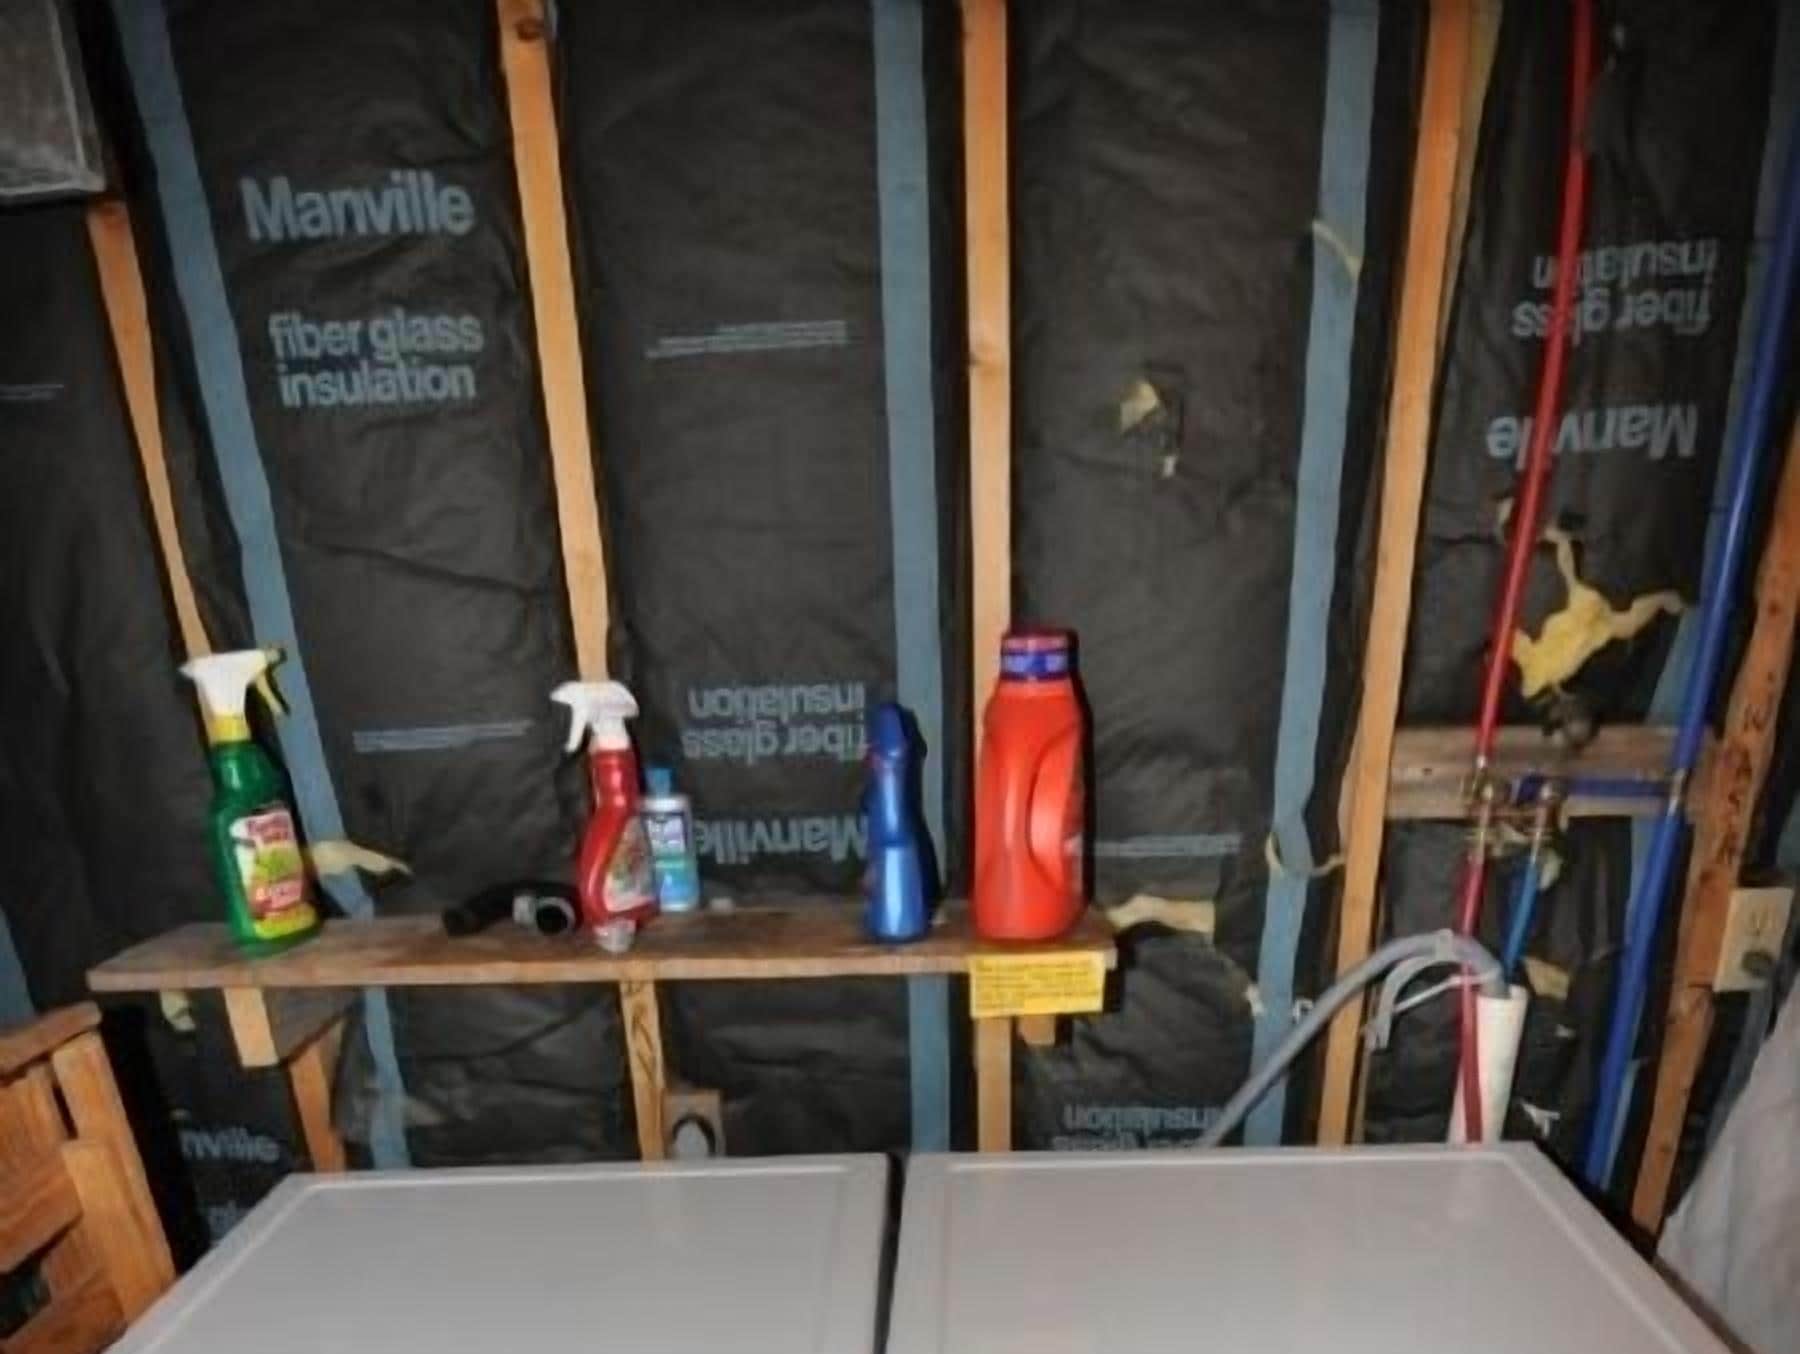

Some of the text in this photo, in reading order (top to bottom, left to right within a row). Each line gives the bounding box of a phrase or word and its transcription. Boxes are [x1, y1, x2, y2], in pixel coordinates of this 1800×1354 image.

[238, 169, 475, 242] Manville
[1532, 237, 1719, 290] insulatin
[269, 307, 485, 368] fiber glass
[1510, 284, 1712, 346] fiber glss
[276, 357, 477, 407] insulation
[1486, 404, 1700, 470] Manvle
[688, 681, 866, 725] insulation
[680, 719, 868, 767] fiber glass
[693, 814, 869, 866] Manville
